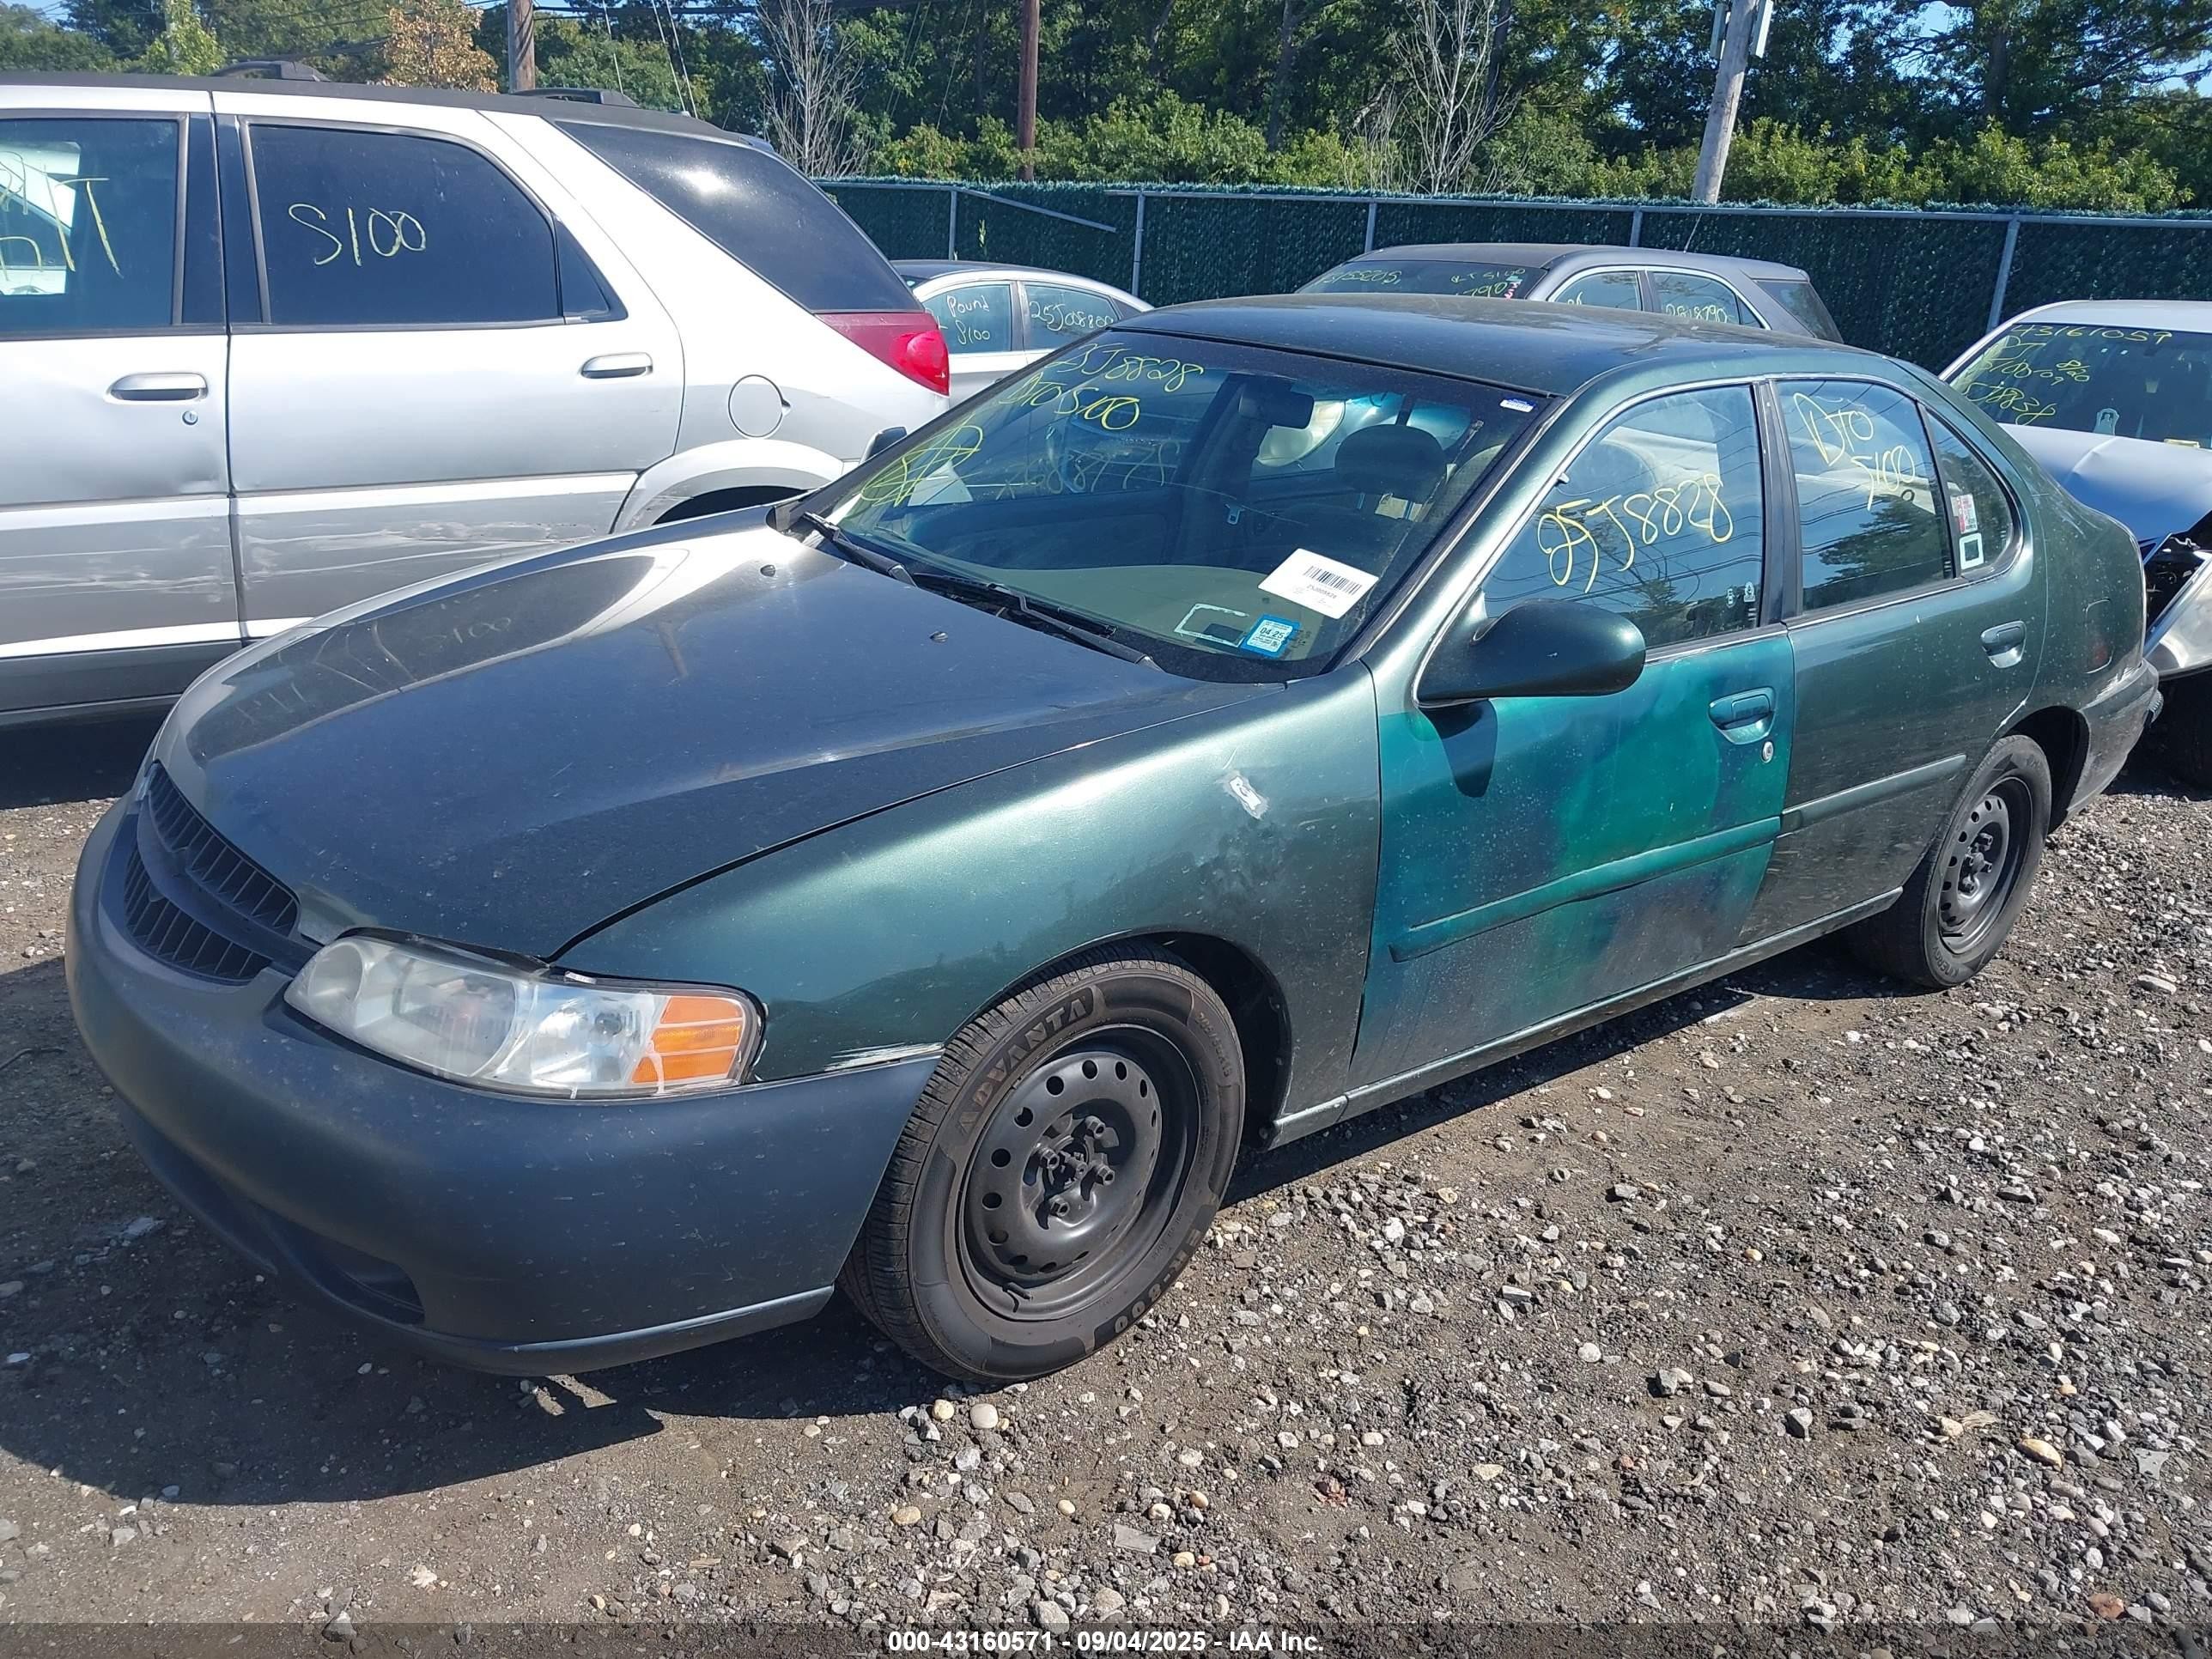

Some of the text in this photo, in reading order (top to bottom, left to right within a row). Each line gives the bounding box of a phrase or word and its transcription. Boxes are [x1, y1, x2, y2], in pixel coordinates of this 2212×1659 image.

[289, 204, 427, 266] S100
[947, 295, 990, 318] Pound
[2011, 325, 2172, 344] 43161059
[1537, 474, 1734, 593] 25J8828
[958, 996, 1088, 1136] ADVANTA
